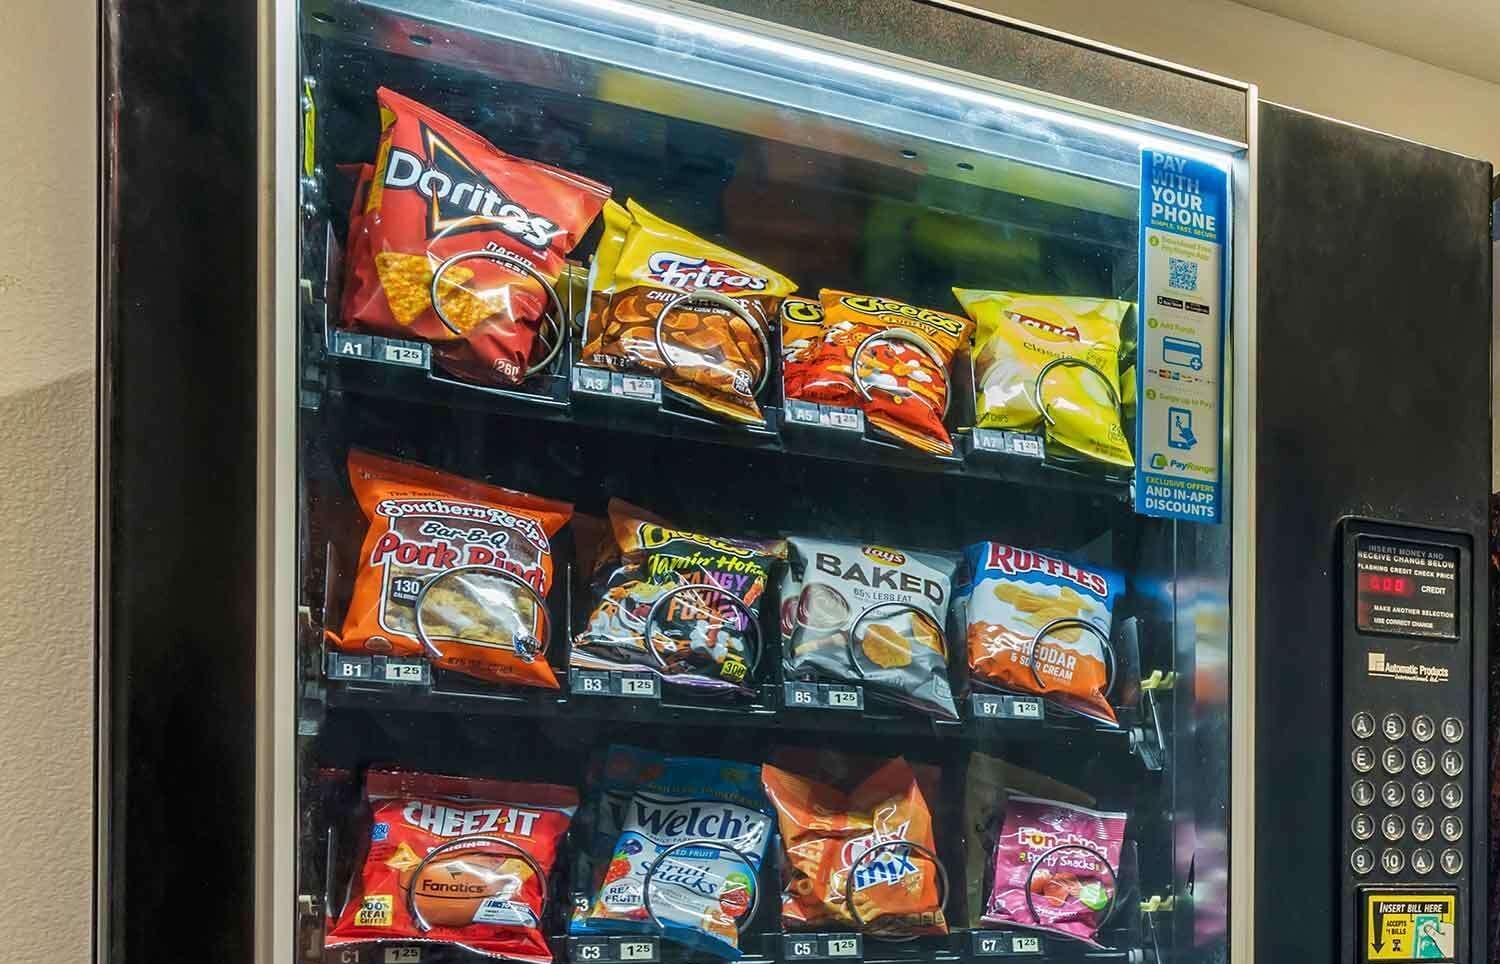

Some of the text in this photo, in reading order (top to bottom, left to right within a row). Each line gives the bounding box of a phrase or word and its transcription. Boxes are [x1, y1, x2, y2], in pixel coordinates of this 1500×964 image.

[1152, 152, 1187, 171] PAY
[1152, 170, 1200, 194] WITH
[386, 149, 556, 248] Doritos
[1152, 186, 1202, 211] YOUR
[1152, 203, 1216, 231] PHONE
[649, 251, 770, 291] Fritos
[842, 297, 964, 336] Cheetos
[343, 341, 363, 355] A1
[585, 379, 604, 391] A3
[1146, 485, 1214, 503] AND IN-APP
[380, 499, 487, 521] Southern
[1145, 498, 1215, 518] DISCOUNTS
[422, 521, 507, 548] Bar-B-Q
[372, 534, 457, 569] Pork
[1368, 545, 1444, 560] INSERT MONEY AND
[1357, 551, 1455, 569] RECEIVE CHANGE BELOW
[987, 541, 1108, 597] RUFFLES
[1390, 566, 1412, 575] CREDIT
[1414, 569, 1434, 578] CHECK
[1436, 572, 1455, 580] PRICE
[394, 579, 419, 594] 130
[816, 552, 944, 606] BAKED
[853, 587, 912, 604] 65% LESS FAT
[1420, 585, 1446, 595] CREDIT
[1373, 604, 1454, 619] MAKE ANOTHER SELECTION
[343, 664, 361, 676] B1
[1042, 664, 1074, 682] CREAM
[1385, 662, 1449, 678] Automatic Products
[584, 678, 602, 691] B3
[795, 691, 811, 704] B5
[983, 702, 998, 715] B7
[1356, 719, 1456, 737] A B C D
[1356, 752, 1456, 770] E F G H
[1358, 787, 1455, 802] 1 2 3 4
[1357, 821, 1455, 836] 5 6 7 8
[688, 848, 714, 858] FRUIT
[1356, 854, 1399, 868] 9 10
[855, 853, 917, 889] mix
[1060, 856, 1096, 872] Snacks
[422, 879, 487, 895] Fanatics
[1379, 901, 1444, 914] INSERT BILL HERE
[1391, 927, 1407, 936] BILLS
[582, 947, 600, 959] C3
[794, 943, 811, 955] C5
[982, 940, 997, 952] C7
[341, 951, 360, 964] C1
